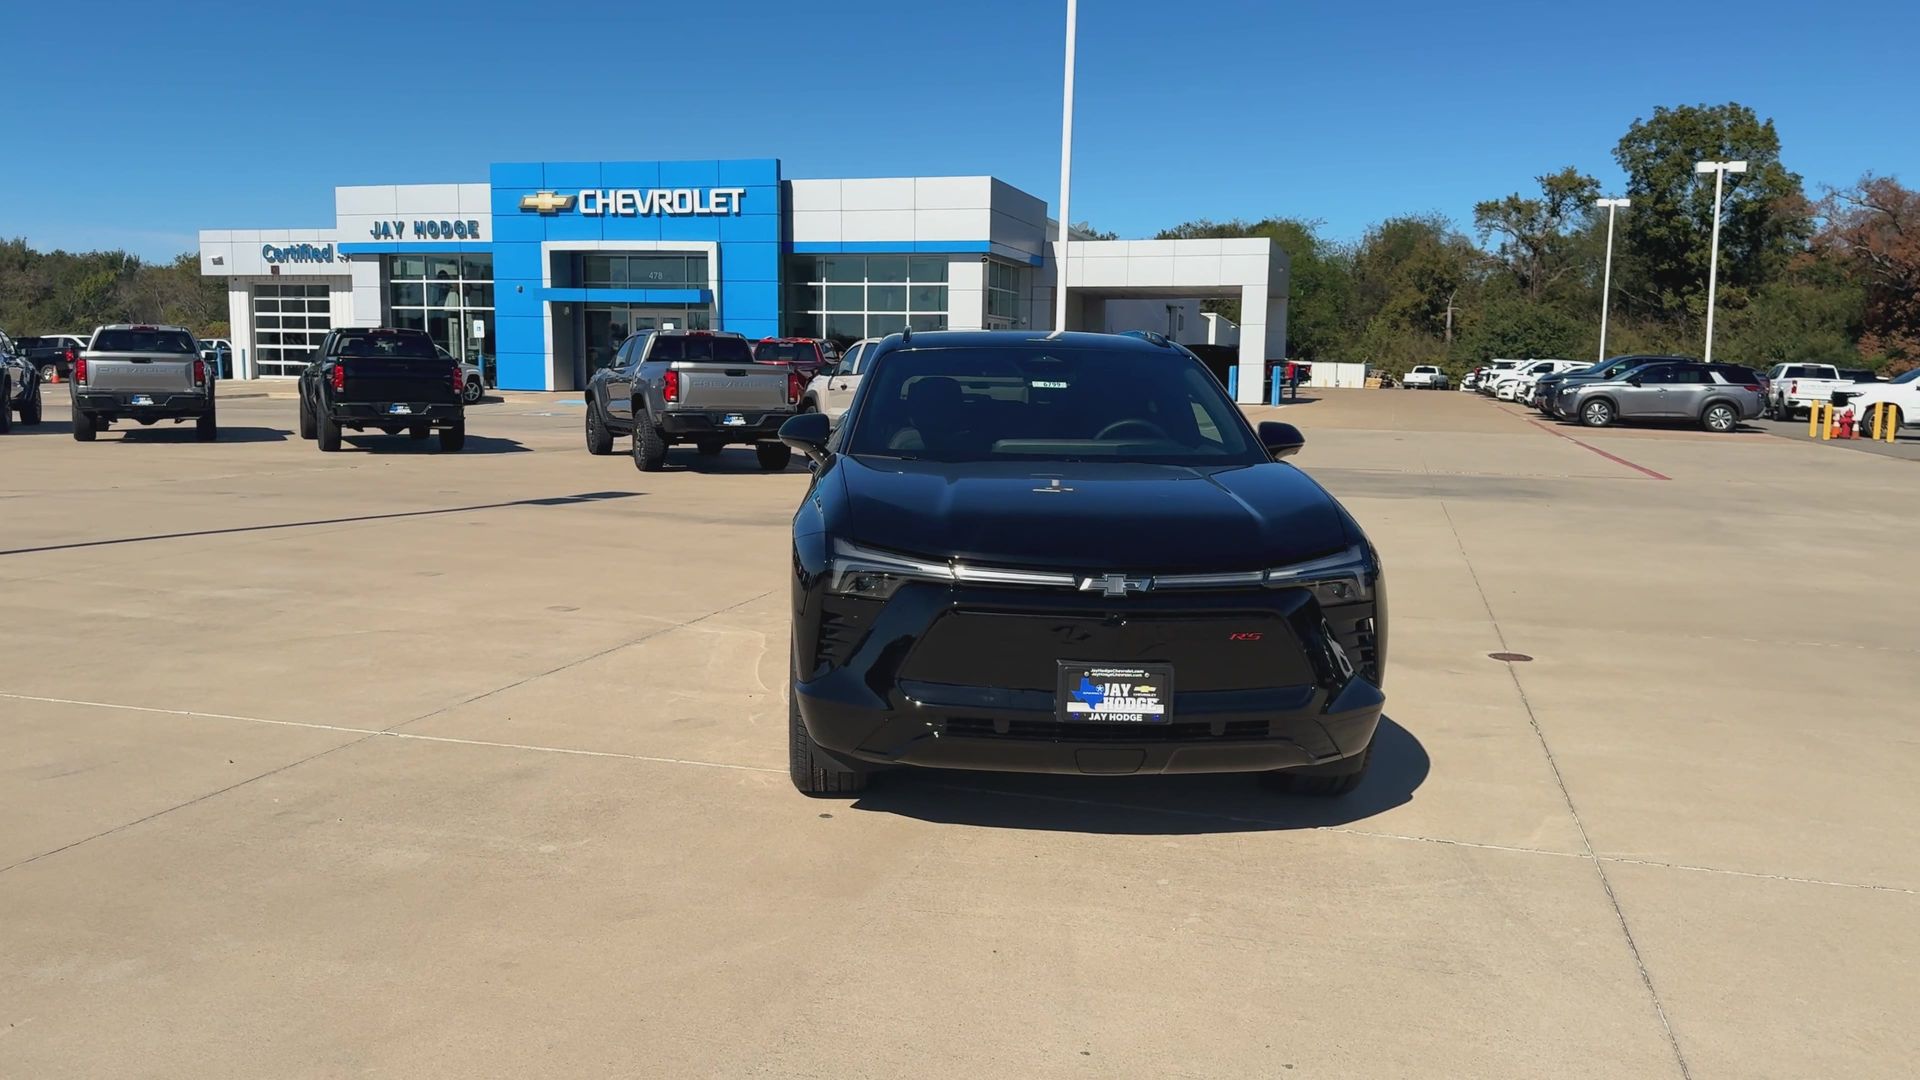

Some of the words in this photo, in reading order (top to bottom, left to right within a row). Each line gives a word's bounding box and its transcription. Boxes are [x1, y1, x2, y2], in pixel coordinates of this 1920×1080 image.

[578, 188, 745, 215] CHEVROLET
[370, 220, 405, 239] JAY
[414, 220, 480, 239] HODGE
[262, 243, 334, 263] Certified
[648, 271, 663, 280] 478
[1229, 632, 1263, 640] RS
[1103, 683, 1131, 696] JAY
[1103, 697, 1159, 710] HODGE
[1089, 713, 1107, 721] JAY
